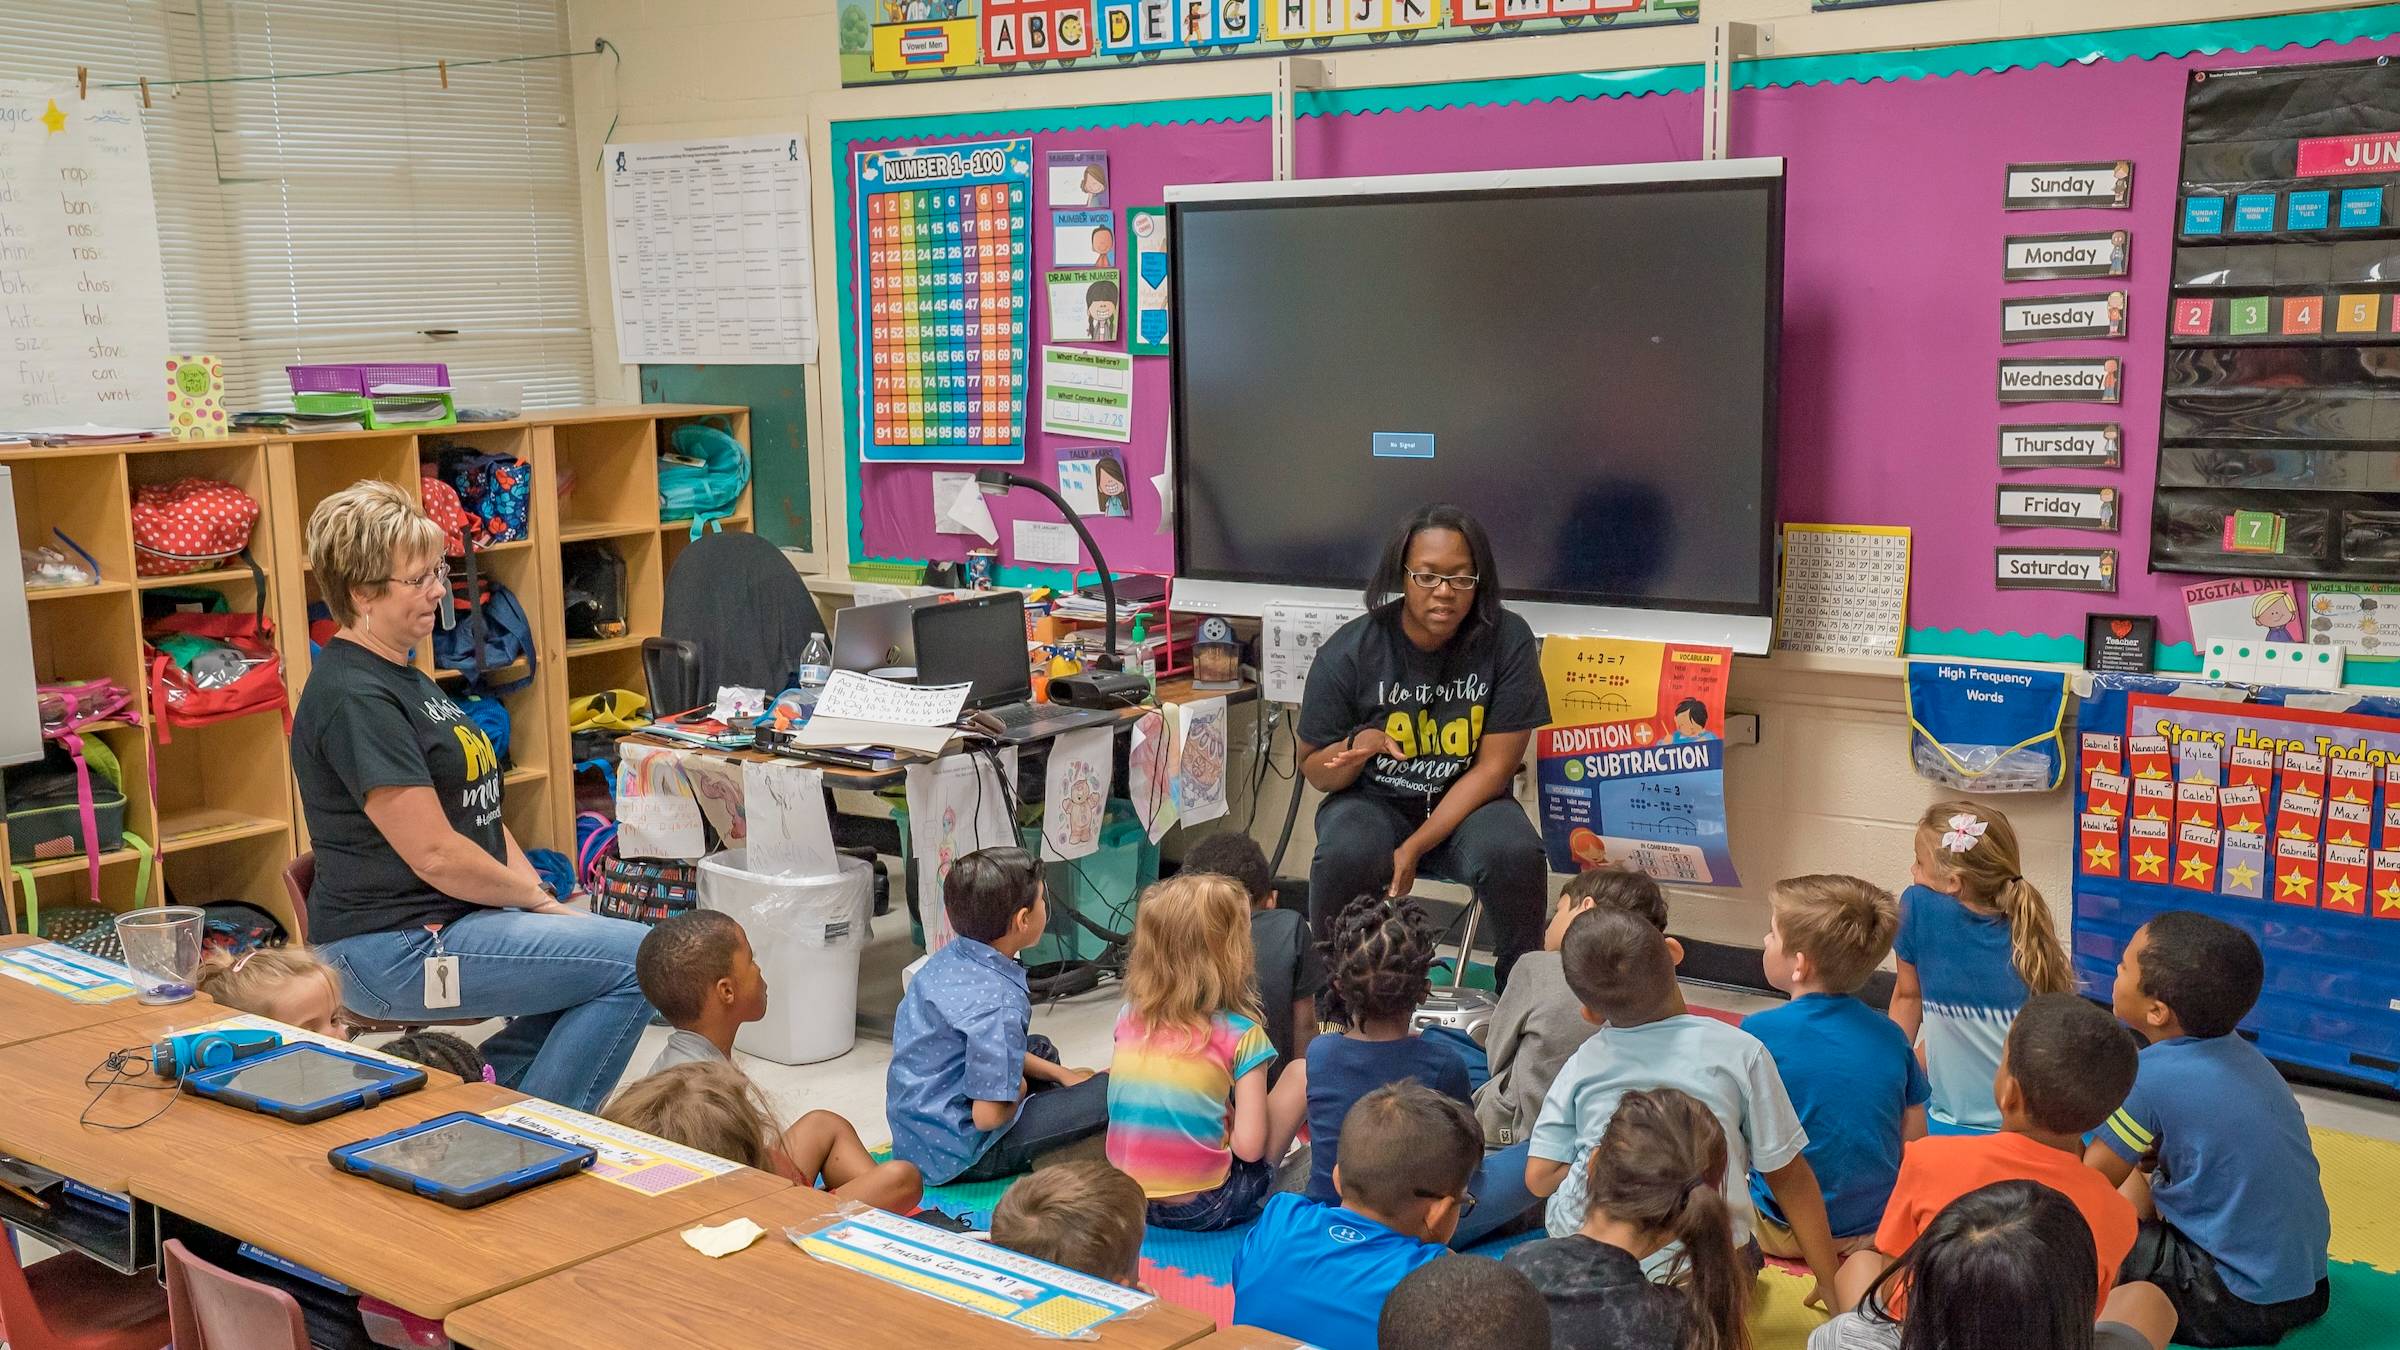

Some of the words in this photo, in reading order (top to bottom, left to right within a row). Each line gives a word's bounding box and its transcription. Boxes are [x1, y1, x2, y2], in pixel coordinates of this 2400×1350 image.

[1148, 6, 1162, 38] E
[1223, 0, 1247, 31] G
[997, 19, 1015, 51] A
[1030, 16, 1046, 48] B
[1058, 14, 1082, 46] C
[1109, 10, 1129, 43] D
[906, 42, 926, 51] Vowel
[928, 40, 943, 50] Men
[2345, 141, 2400, 167] JUN
[884, 156, 949, 181] NUMBER
[951, 155, 962, 176] 1
[972, 151, 1004, 174] 100
[2031, 176, 2095, 195] Sunday
[873, 202, 880, 213] 1
[889, 200, 896, 211] 2
[903, 199, 910, 210] 3
[918, 198, 925, 209] 4
[933, 197, 941, 208] 5
[948, 196, 955, 207] 6
[964, 194, 971, 206] 7
[980, 193, 988, 205] 8
[997, 192, 1004, 204] 9
[1011, 190, 1023, 202] 10
[1058, 214, 1088, 223] NUMBER
[1090, 214, 1109, 222] WORD
[872, 226, 883, 239] 11
[887, 225, 898, 237] 12
[902, 224, 913, 236] 13
[917, 223, 928, 235] 14
[931, 223, 944, 235] 15
[946, 222, 958, 234] 16
[962, 220, 975, 232] 17
[979, 219, 991, 231] 18
[995, 218, 1007, 230] 19
[1011, 217, 1023, 229] 20
[2025, 246, 2097, 264] Monday
[1048, 273, 1072, 282] DRAW
[1074, 272, 1088, 281] THE
[1089, 271, 1118, 281] NUMBER
[2022, 308, 2095, 326] Tuesday
[2188, 307, 2202, 326] 2
[2245, 306, 2258, 324] 3
[2297, 306, 2311, 325] 4
[2354, 304, 2366, 322] 5
[1057, 353, 1073, 361] What
[1074, 355, 1094, 364] Comes
[1095, 357, 1121, 366] Before?
[2003, 371, 2104, 389] Wednesday
[1058, 392, 1074, 400] What
[1075, 394, 1095, 403] Comes
[1096, 396, 1117, 405] After?
[1399, 441, 1416, 449] Signal
[2014, 437, 2095, 455] Thursday
[2024, 496, 2081, 516] Friday
[2249, 521, 2261, 538] 7
[2010, 559, 2090, 578] Saturday
[2186, 582, 2248, 603] DIGITAL
[2253, 578, 2289, 593] DATE
[2310, 583, 2341, 592] What's
[2345, 583, 2361, 592] the
[2105, 637, 2139, 646] Teacher
[1577, 652, 1583, 663] 4
[1598, 653, 1604, 664] 3
[1619, 655, 1625, 665] 7
[1680, 653, 1713, 662] VOCABULARY
[1938, 667, 1966, 681] High
[1970, 668, 2033, 687] Frequency
[1378, 681, 1384, 705] I
[1388, 682, 1412, 705] do
[1453, 673, 1489, 702] the
[1966, 689, 2004, 703] Words
[1384, 704, 1485, 759] Aha!
[1552, 724, 1632, 753] ADDITION
[2083, 738, 2111, 750] Gabriel
[2156, 719, 2226, 749] Stars
[2236, 728, 2305, 757] Here
[2315, 735, 2400, 768] Today
[1585, 745, 1709, 778] SUBTRACTION
[2184, 747, 2214, 761] Kylee
[2236, 752, 2270, 767] Josiah
[2336, 764, 2368, 778] Zymir
[1552, 786, 1585, 797] VOCABULARY
[1640, 782, 1647, 792] 7
[1654, 784, 1660, 793] 4
[1675, 785, 1681, 796] 3
[2094, 778, 2120, 794] Terry
[2140, 785, 2163, 796] Han
[2182, 789, 2212, 802] Caleb
[2224, 792, 2255, 804] Ethan
[2283, 799, 2318, 818] Sammy
[2334, 806, 2359, 821] Max
[2132, 825, 2166, 836] Armando
[2184, 830, 2216, 844] Farrah
[1647, 843, 1680, 852] COMPARISON
[2227, 836, 2264, 851] Salarah
[2279, 843, 2316, 859] Gabriella
[2329, 850, 2366, 865] Aniyah
[877, 1241, 932, 1263] Armando
